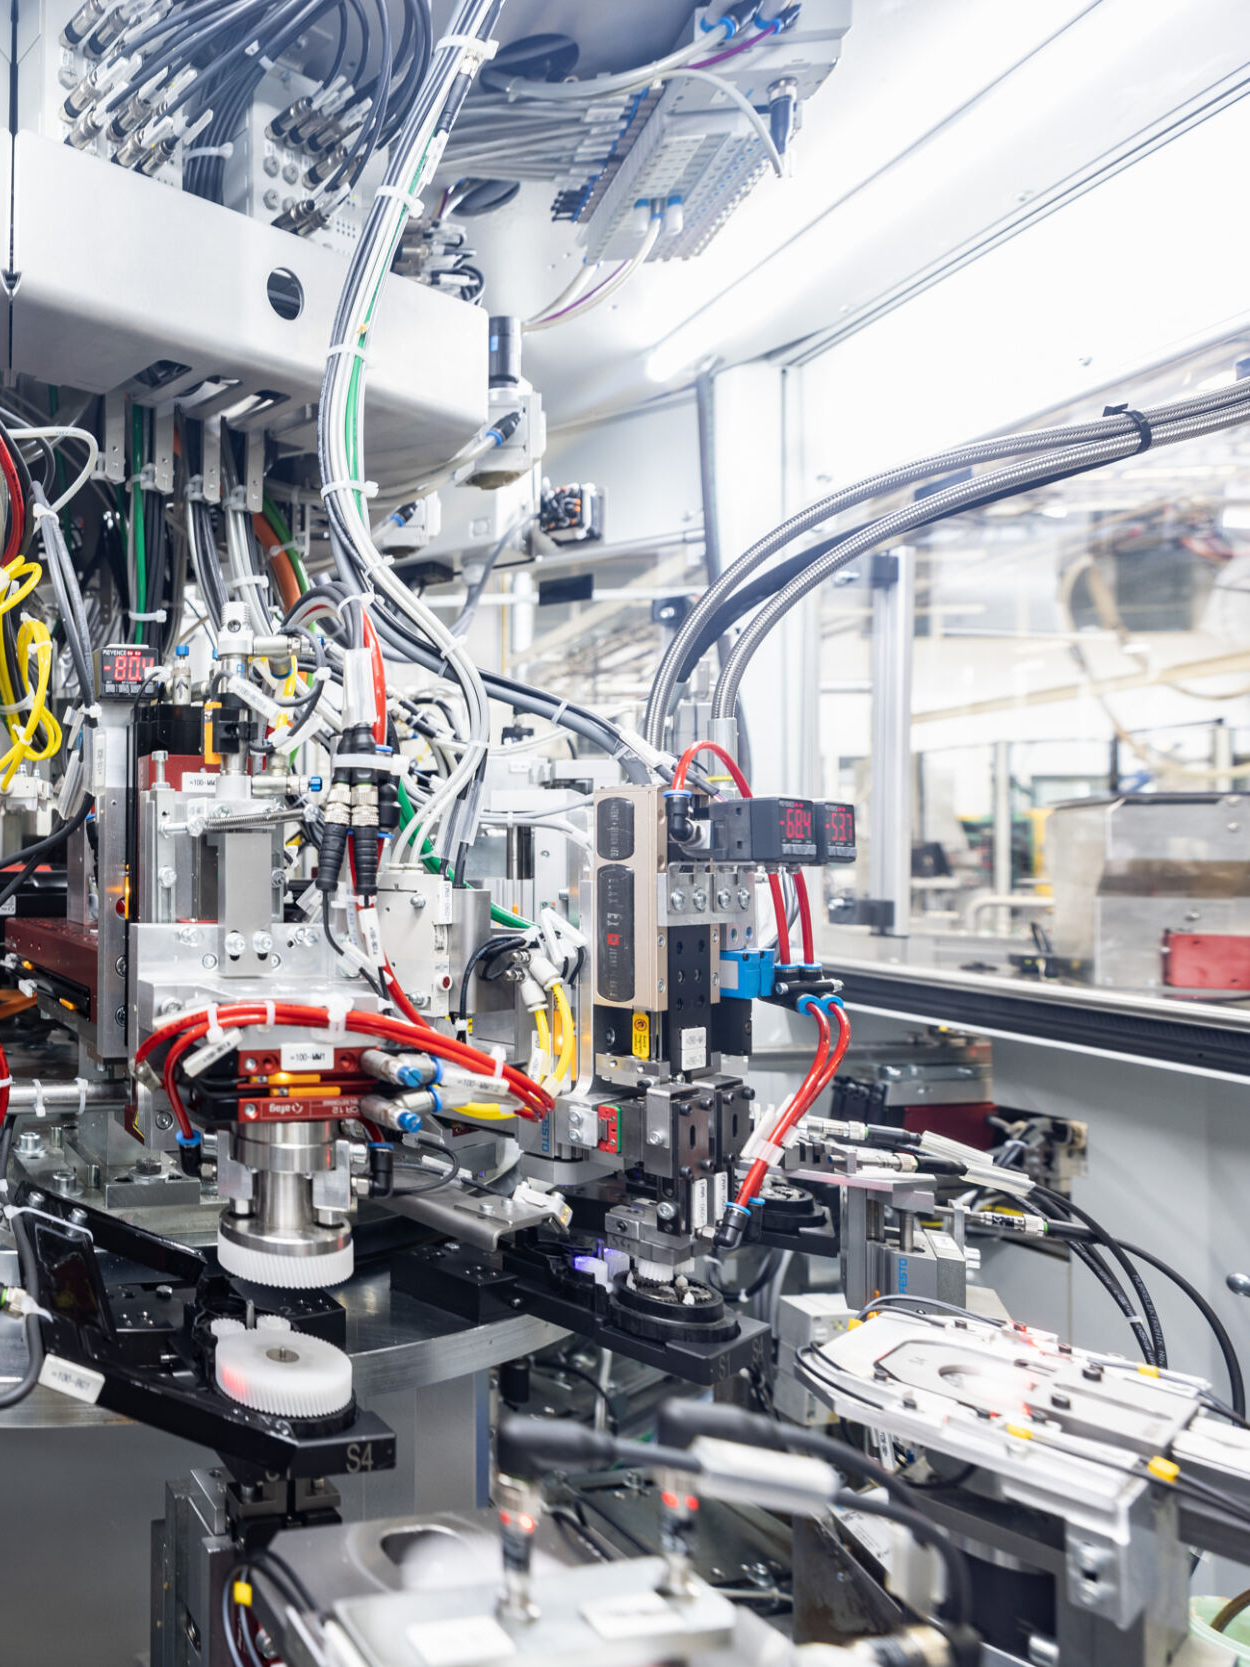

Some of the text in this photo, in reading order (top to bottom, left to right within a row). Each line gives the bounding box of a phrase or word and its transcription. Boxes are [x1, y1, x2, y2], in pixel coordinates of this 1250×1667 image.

[268, 1103, 291, 1113] afag
[897, 1257, 908, 1295] FESTO
[346, 1442, 374, 1475] S4
